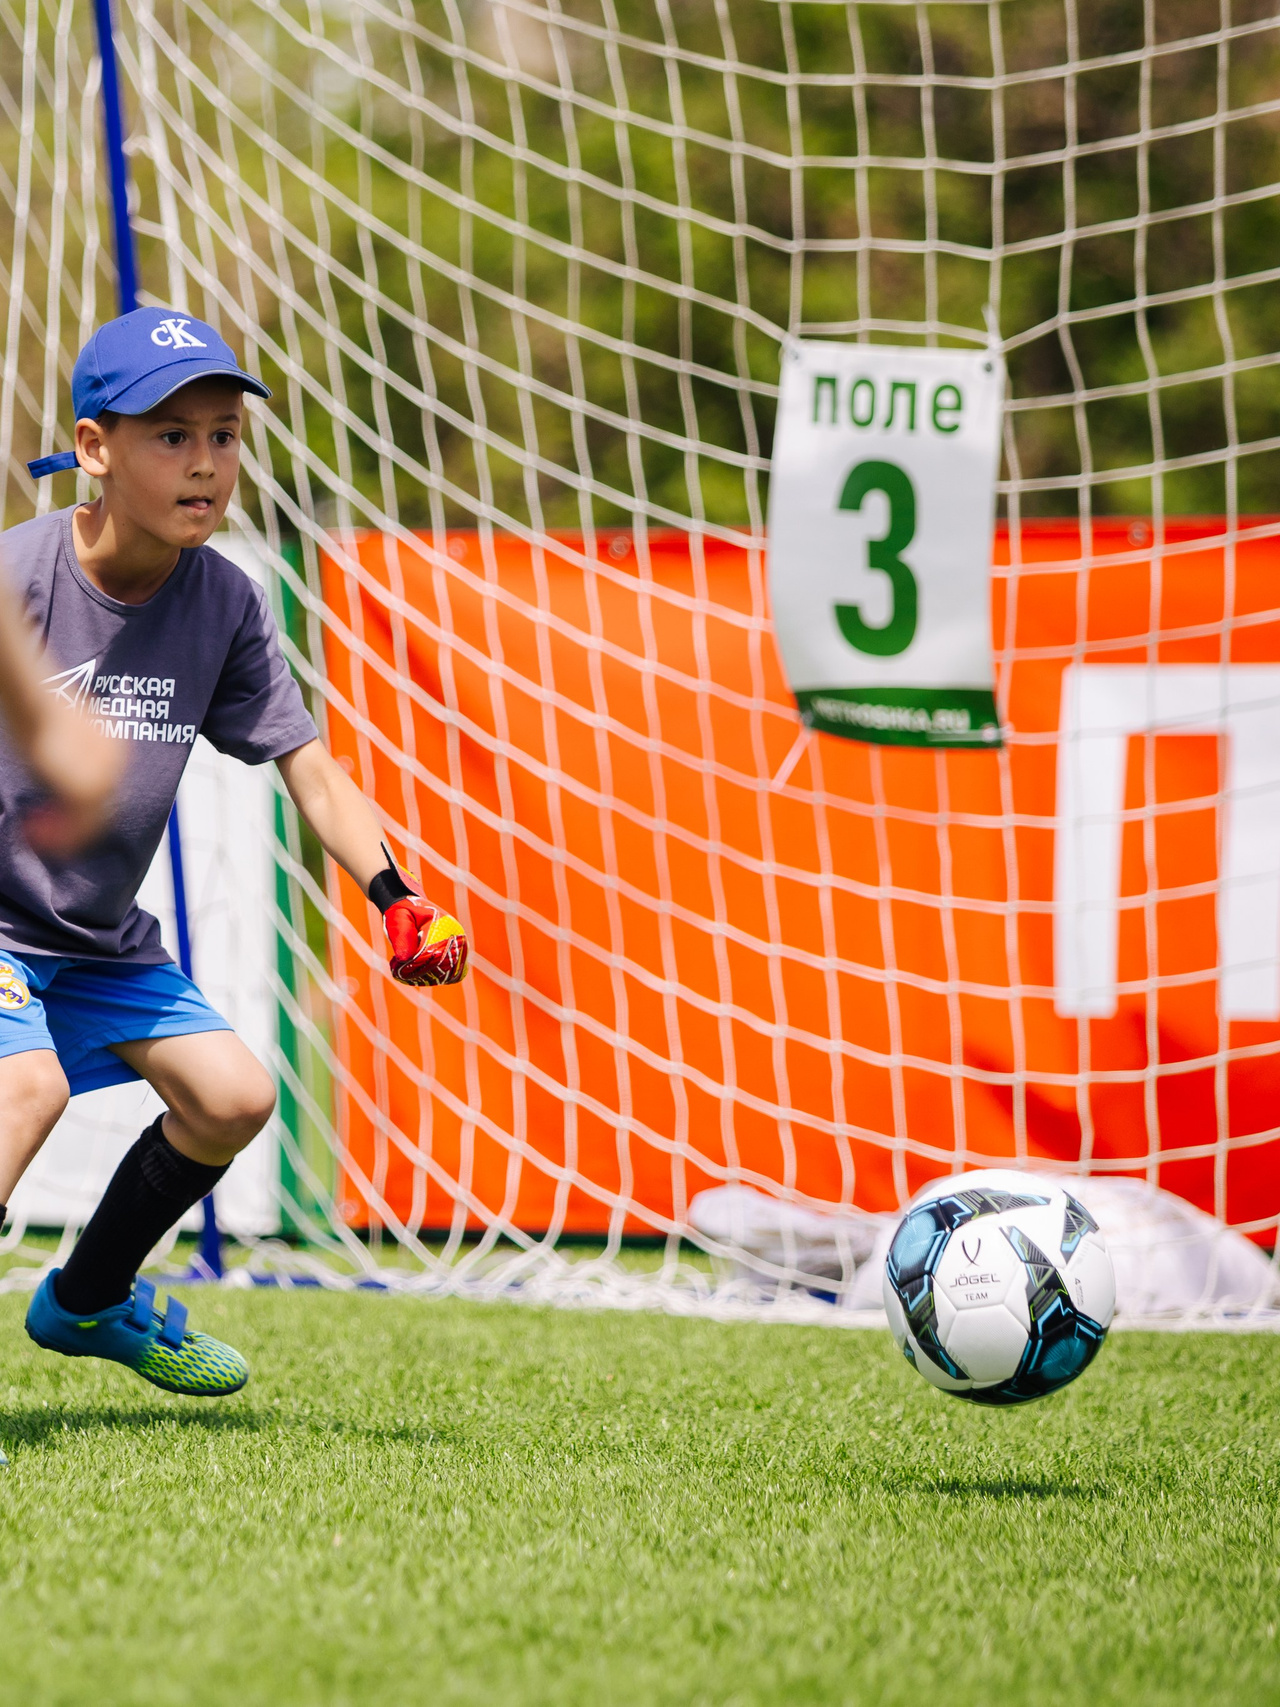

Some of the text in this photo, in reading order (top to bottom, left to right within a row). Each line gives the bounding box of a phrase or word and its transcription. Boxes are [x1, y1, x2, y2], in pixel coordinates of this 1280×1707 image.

[812, 375, 963, 433] поле
[833, 459, 919, 658] 3
[92, 675, 176, 697] РУССКАЯ
[87, 696, 170, 719] МЕДНАЯ
[950, 1273, 1001, 1288] JÖGEL
[965, 1292, 988, 1301] TEAM
